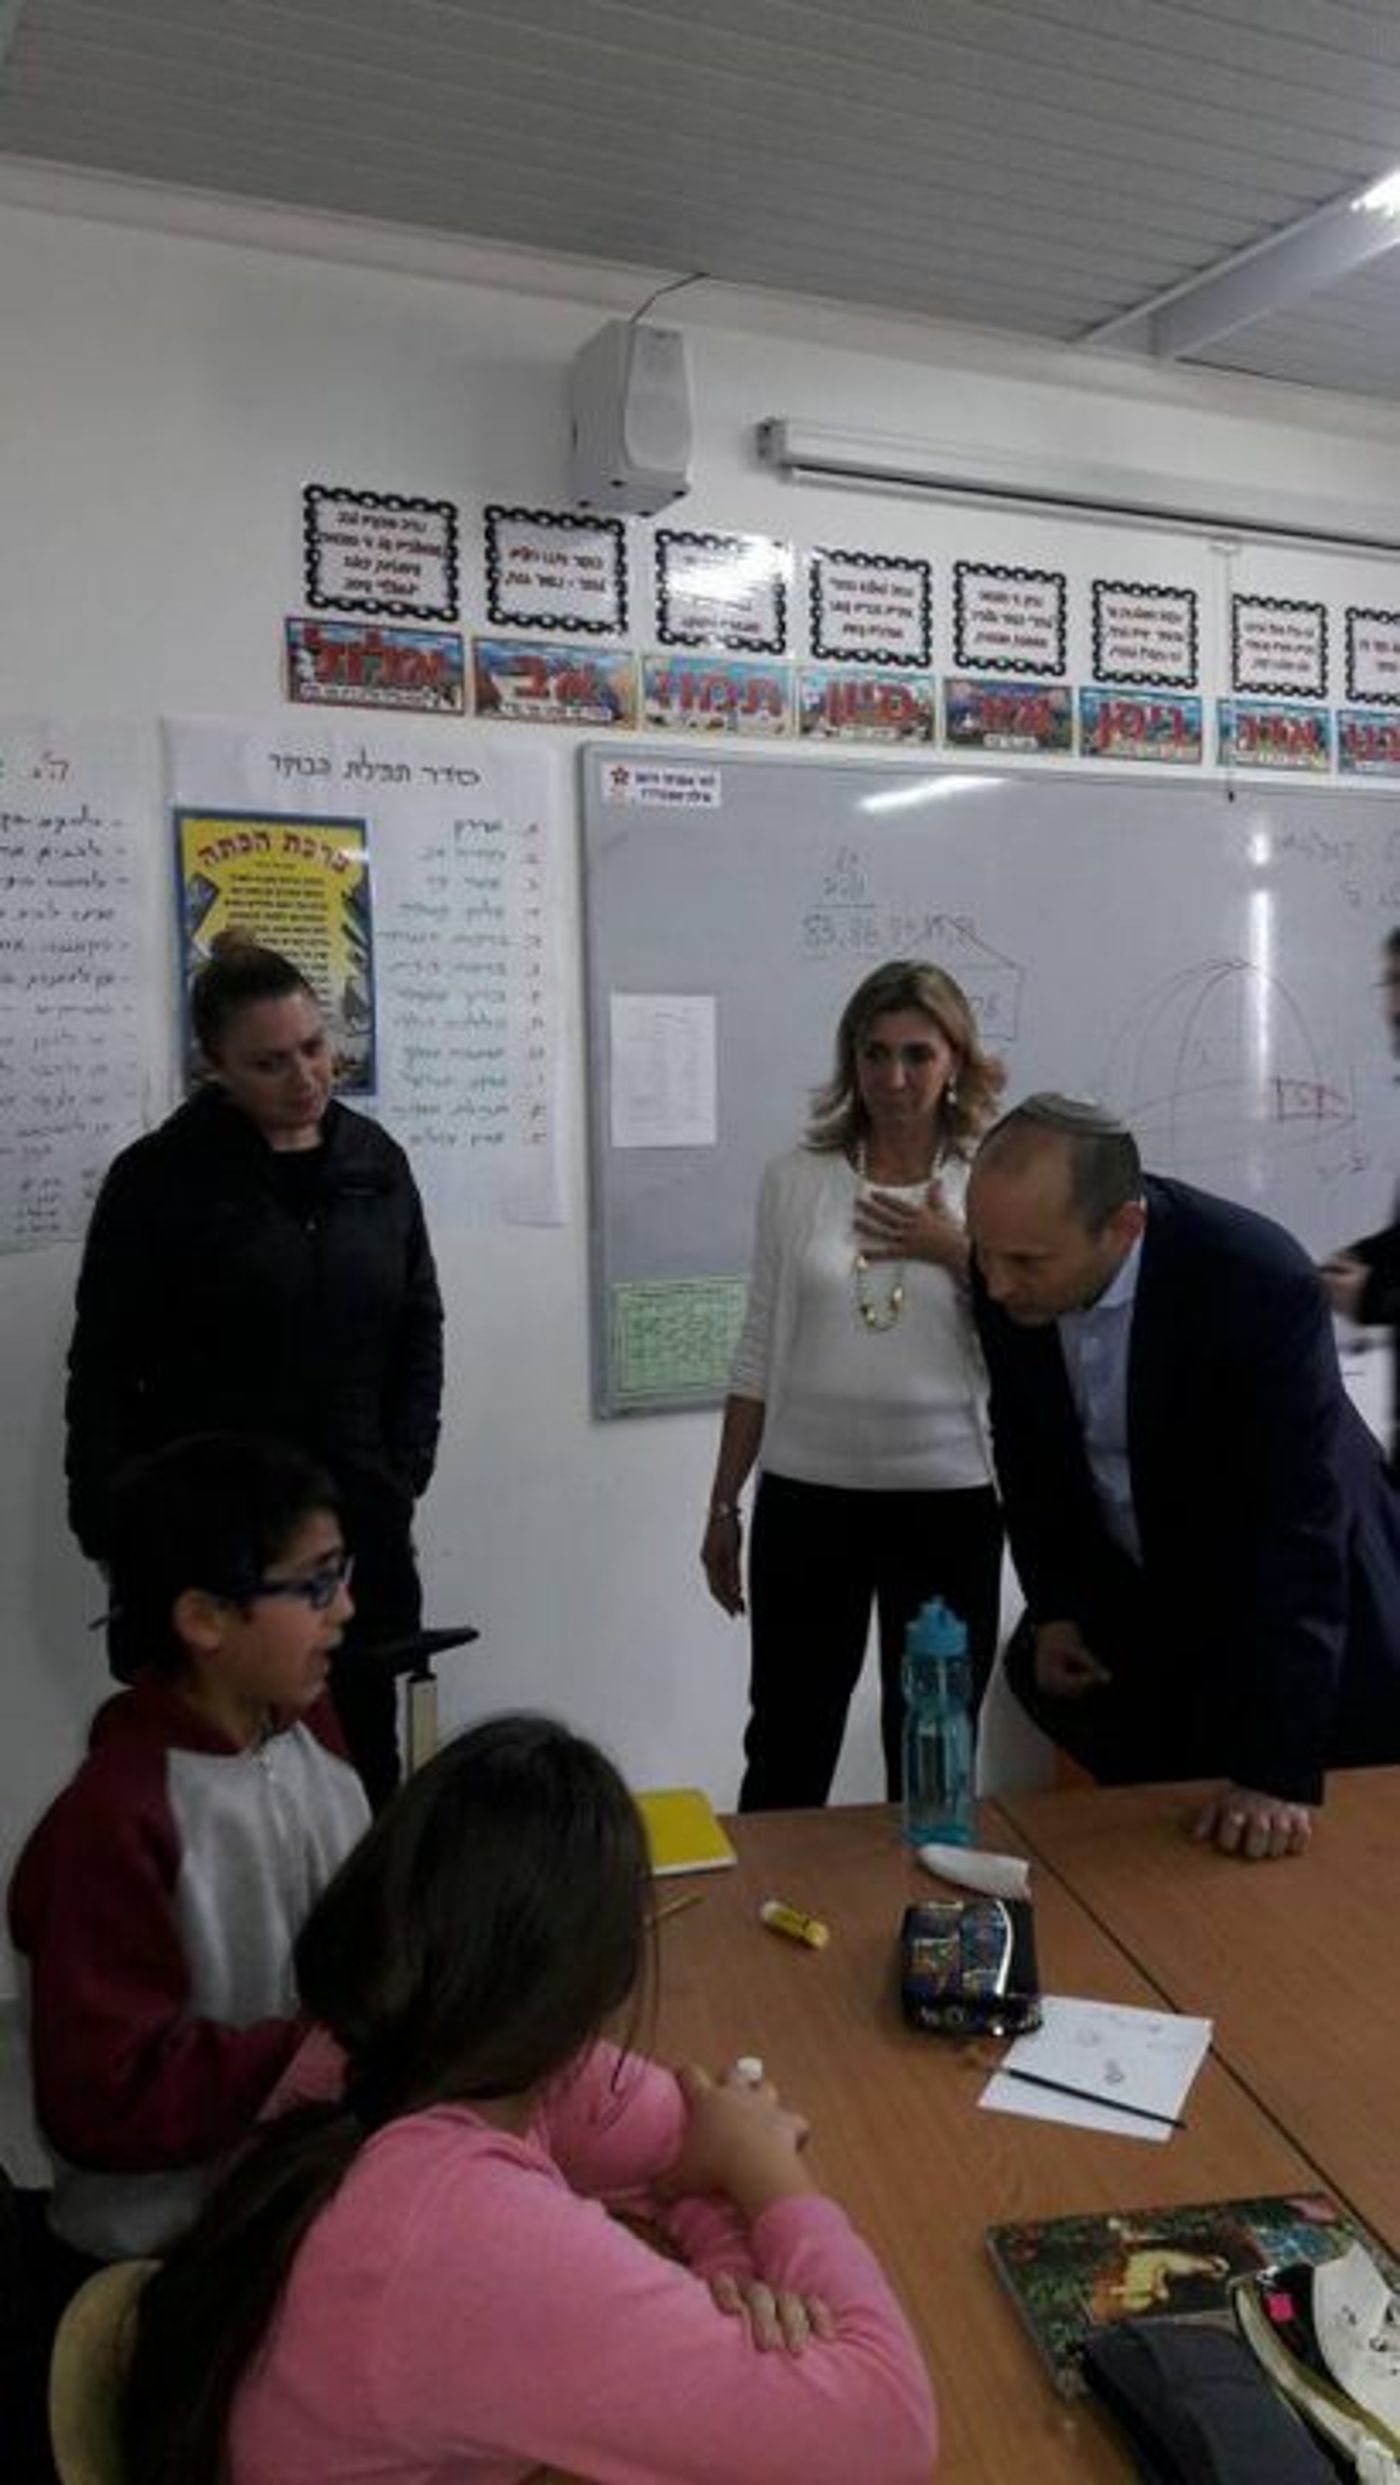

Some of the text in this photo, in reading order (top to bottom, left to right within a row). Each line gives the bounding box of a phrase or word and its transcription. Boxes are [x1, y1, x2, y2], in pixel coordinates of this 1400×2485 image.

[655, 671, 783, 717] תמוז
[826, 680, 916, 727] סיון
[1096, 699, 1185, 749] ניסן
[420, 765, 482, 786] סדר
